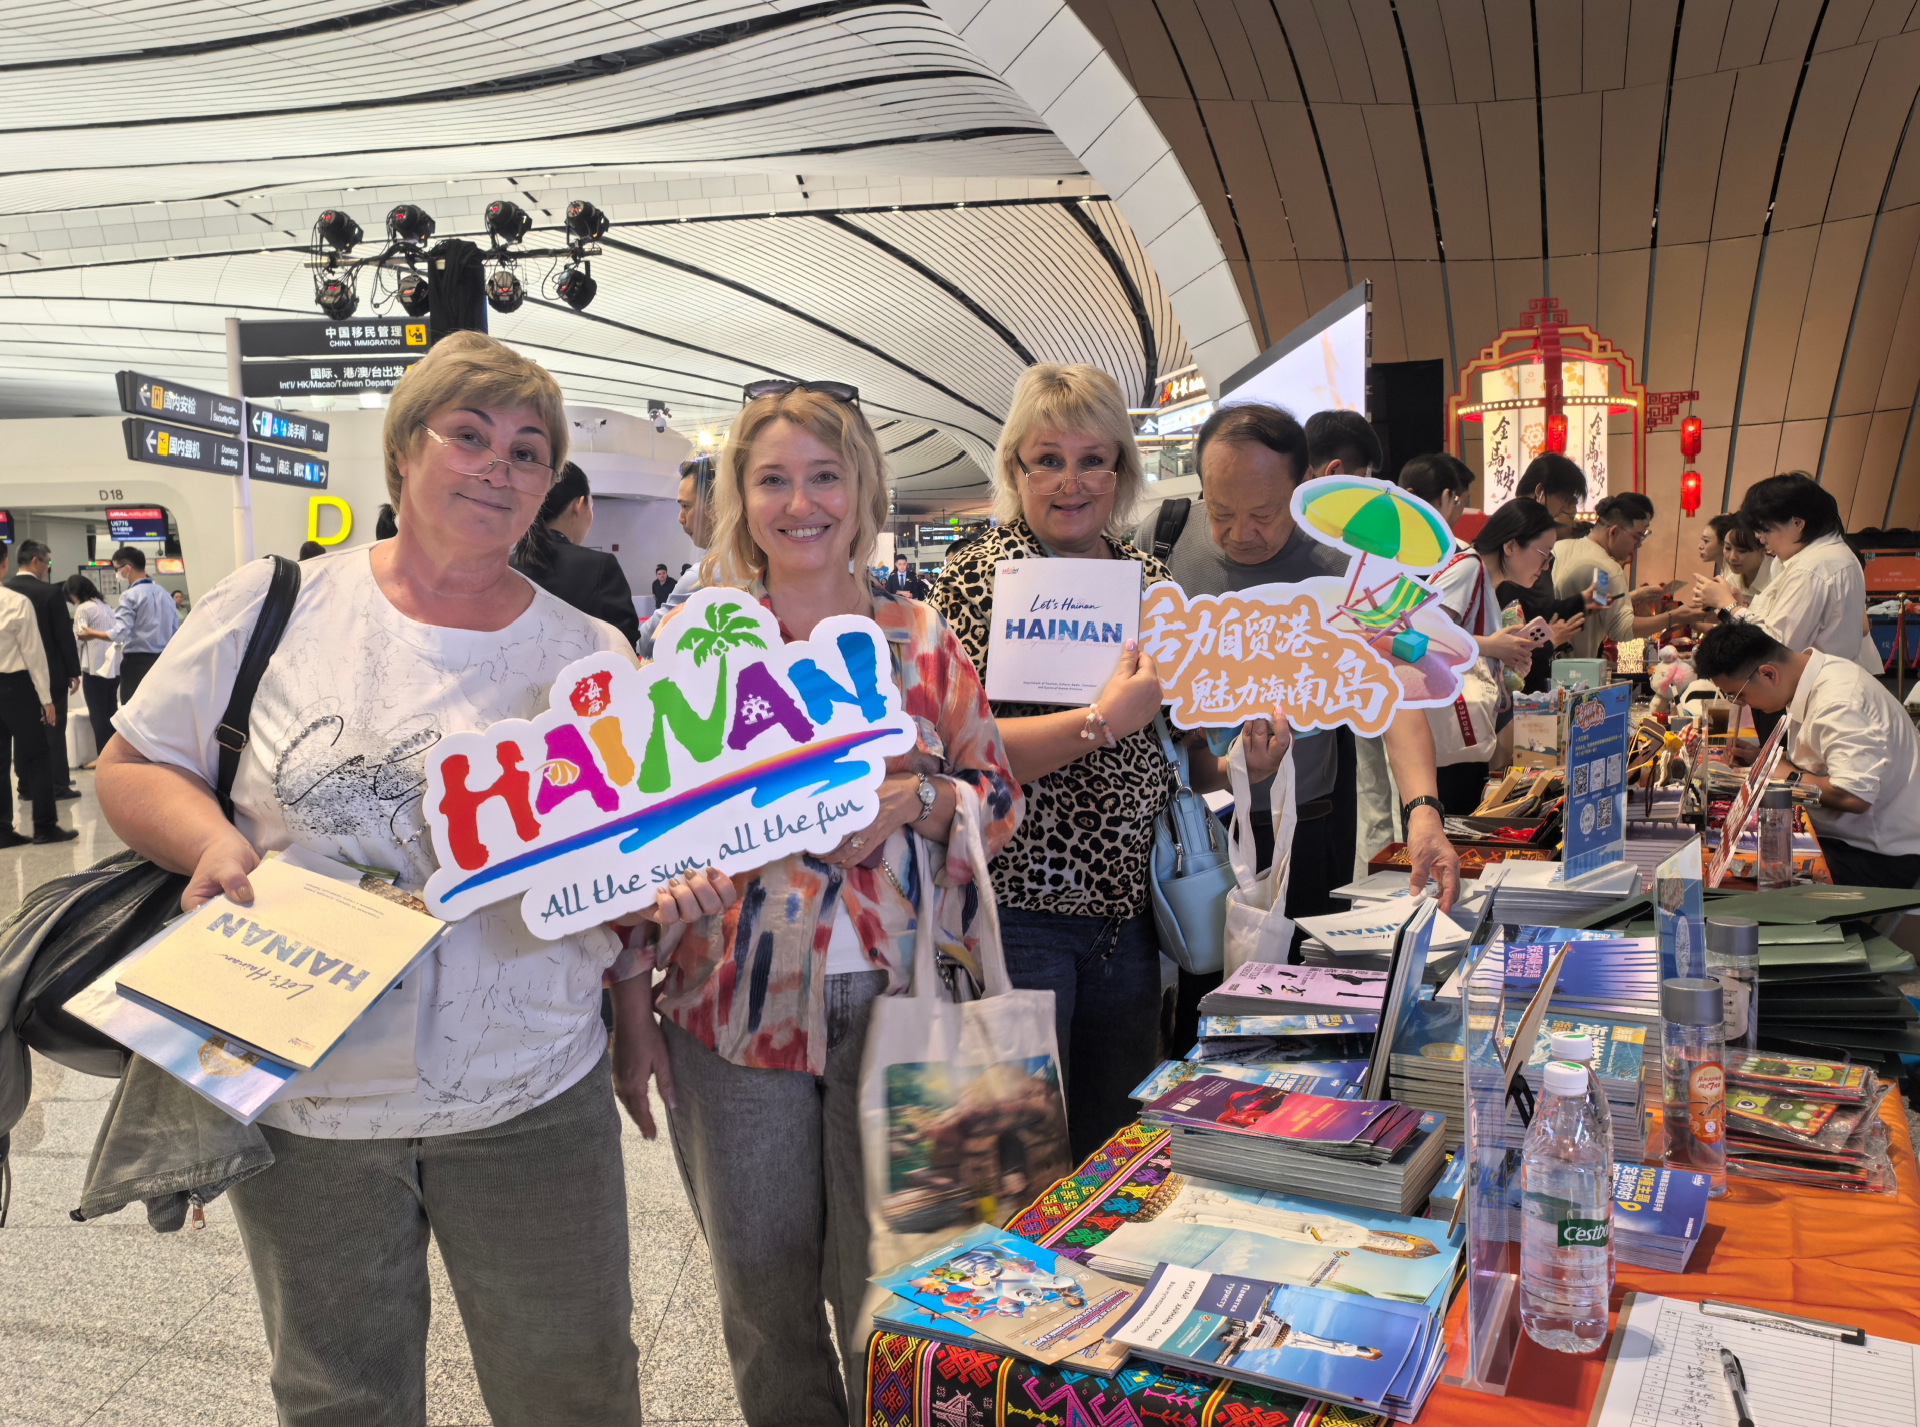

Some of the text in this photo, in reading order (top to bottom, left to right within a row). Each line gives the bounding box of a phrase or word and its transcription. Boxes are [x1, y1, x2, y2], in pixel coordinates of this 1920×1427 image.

[326, 326, 402, 338] 中国移民管理
[310, 366, 404, 379] 国际、港/澳/台出发
[297, 380, 363, 389] HK/Macao/Taiwan
[163, 391, 196, 414] 国内安检
[219, 403, 236, 414] Domestic
[213, 413, 239, 427] Security Check
[287, 422, 306, 440] 洗手间
[312, 429, 324, 442] Toilet
[169, 436, 200, 459] 国内登机
[222, 444, 238, 456] Domestic
[221, 457, 238, 469] Boarding
[260, 452, 271, 464] Shops
[255, 463, 274, 474] Restaurants
[99, 489, 124, 500] D18
[308, 496, 352, 546] D
[1030, 594, 1103, 612] Let's Hainan
[1006, 618, 1122, 643] HAINAN
[1186, 648, 1389, 723] 魅力海南岛
[1457, 699, 1471, 736] PROTECT
[438, 602, 887, 871] HAINAN
[541, 883, 589, 923] All
[593, 874, 647, 904] the
[718, 828, 760, 860] all
[764, 812, 810, 846] the
[806, 799, 864, 835] fun
[207, 912, 370, 992] HAINAN
[213, 952, 315, 1000] Let's Hainan
[1181, 1281, 1196, 1300] КИТАЙ
[1216, 1282, 1235, 1308] туристу
[1230, 1284, 1250, 1312] Памятка
[1162, 1303, 1182, 1325] ХАЙНАНЬ
